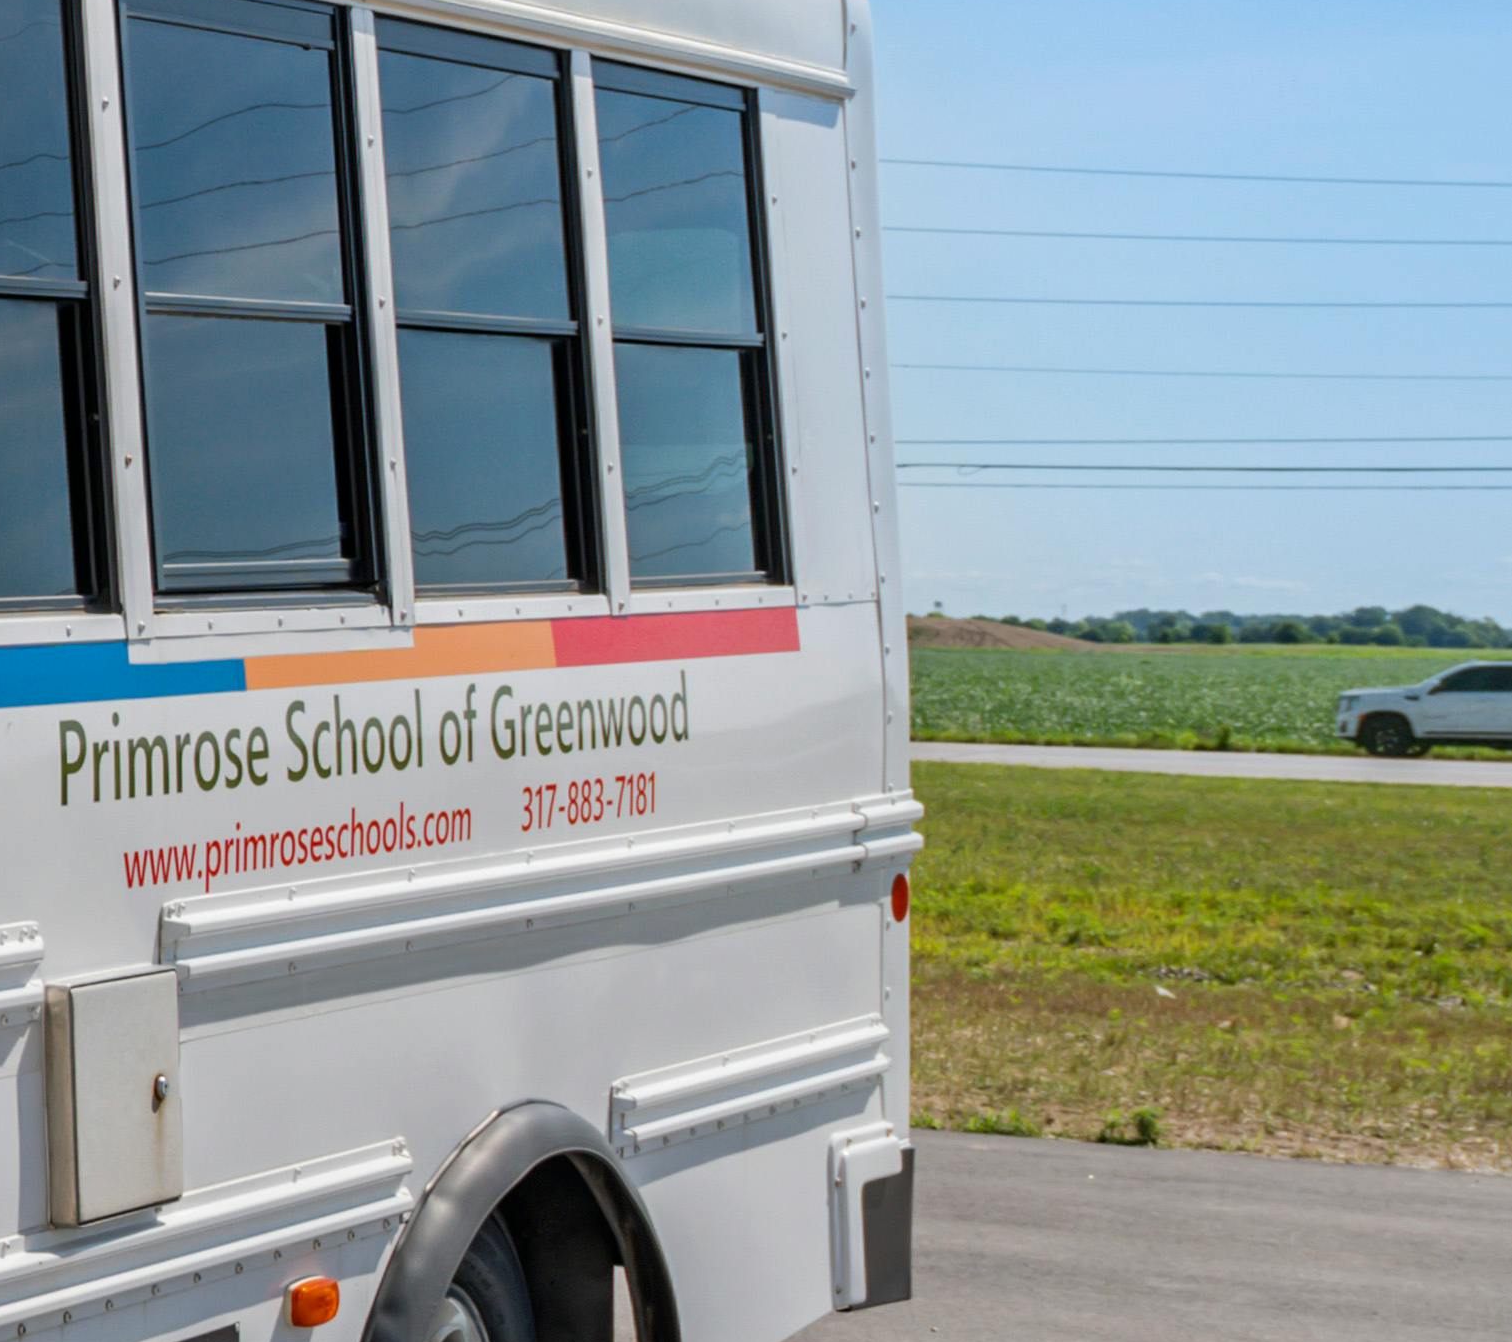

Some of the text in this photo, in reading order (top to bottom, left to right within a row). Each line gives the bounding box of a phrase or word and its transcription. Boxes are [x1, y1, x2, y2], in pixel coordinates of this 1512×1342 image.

[59, 669, 689, 806] Primrose School of Greenwood
[123, 771, 656, 893] www.primroseschools.com 317-883-7181
